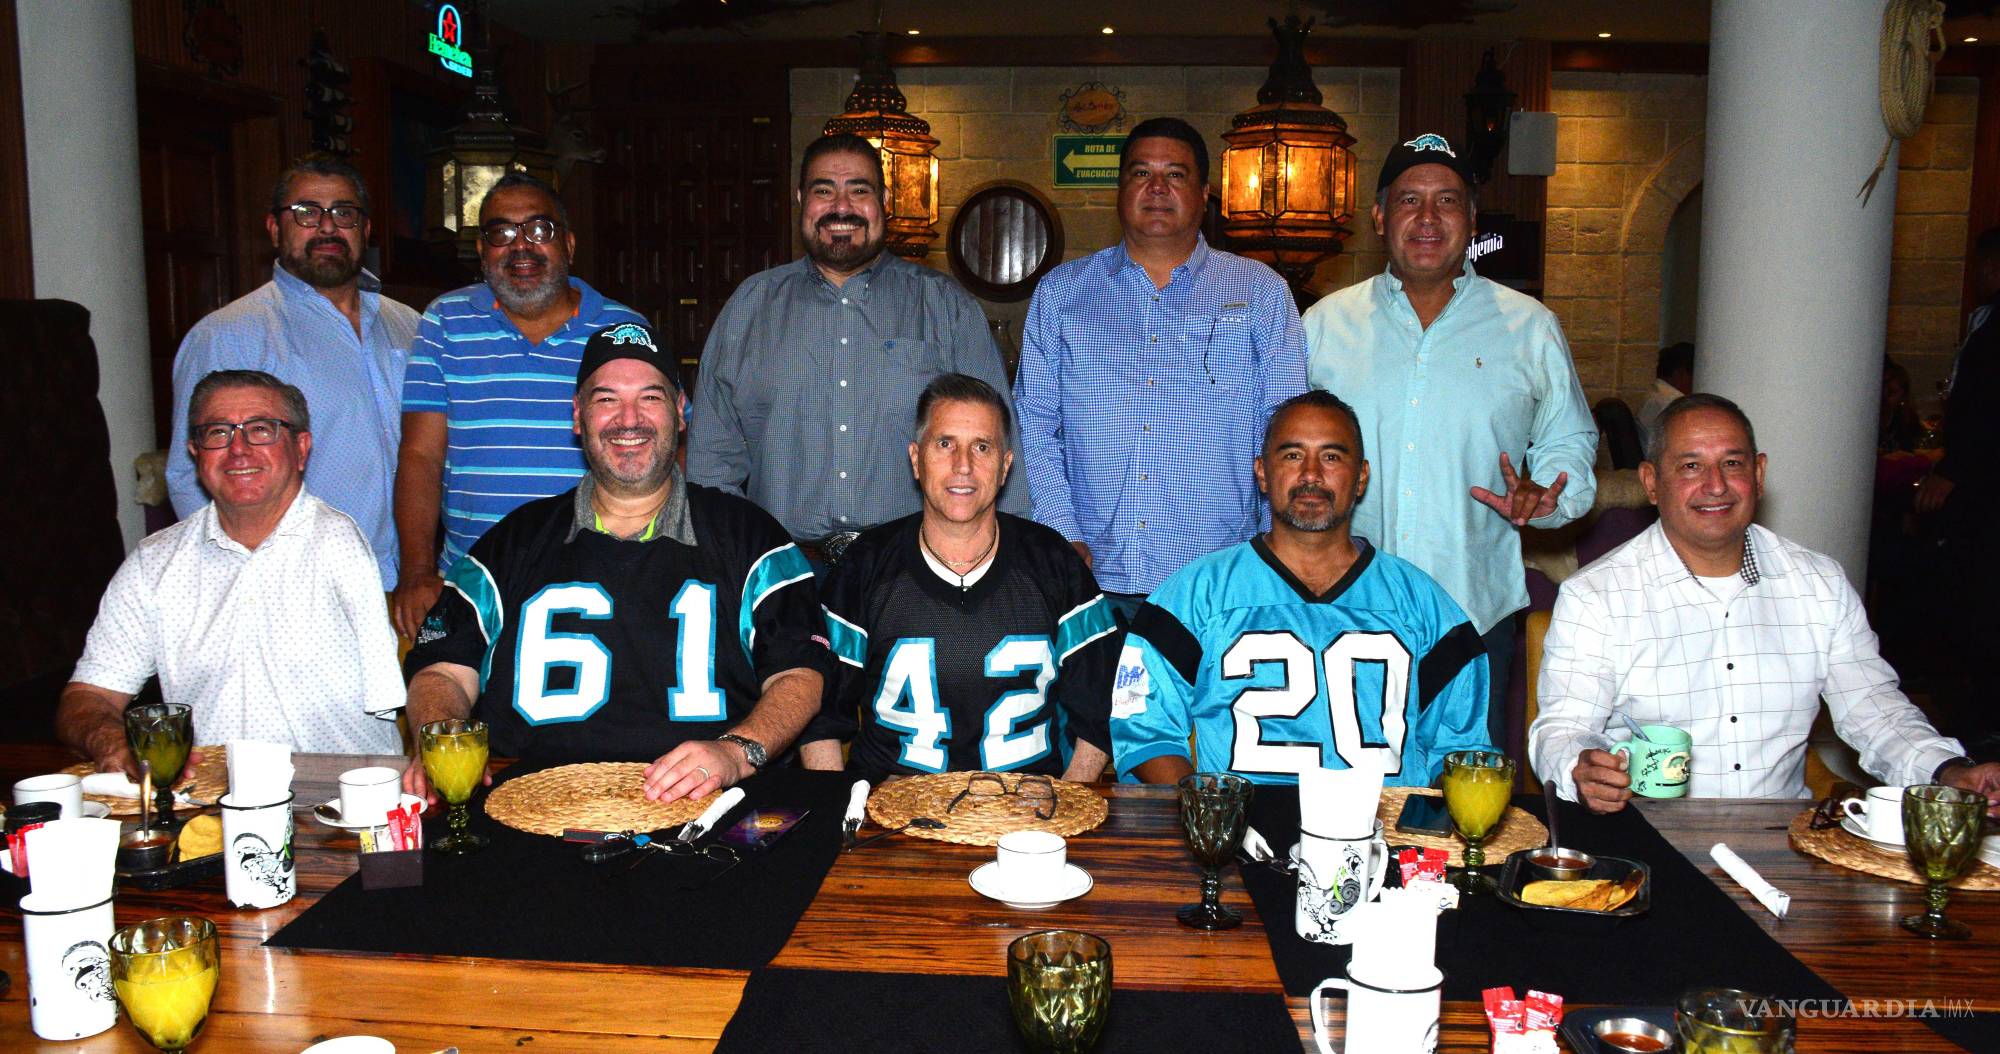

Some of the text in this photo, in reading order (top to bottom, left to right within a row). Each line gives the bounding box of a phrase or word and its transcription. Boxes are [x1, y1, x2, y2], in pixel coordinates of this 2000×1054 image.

[428, 32, 473, 69] Heineken
[1084, 144, 1117, 153] RUTA DE
[1076, 169, 1120, 178] EVACUACIO
[1465, 232, 1503, 263] ohemia
[512, 578, 727, 726] 61
[873, 634, 1059, 773] 42
[1221, 630, 1413, 777] 20
